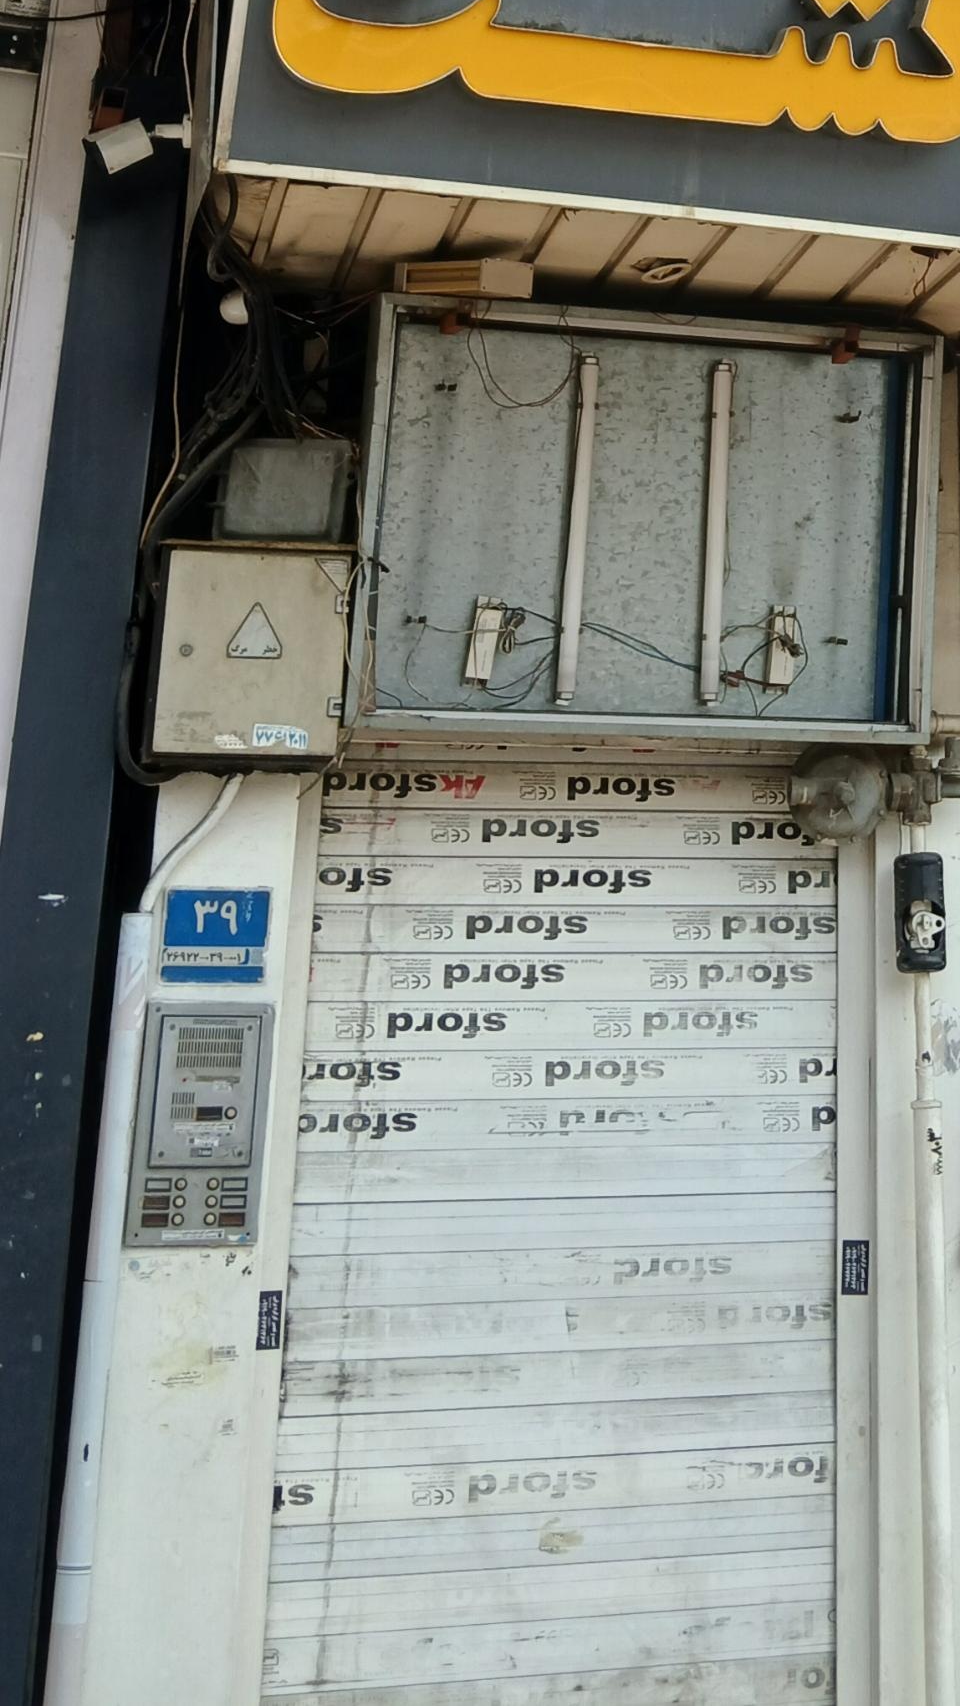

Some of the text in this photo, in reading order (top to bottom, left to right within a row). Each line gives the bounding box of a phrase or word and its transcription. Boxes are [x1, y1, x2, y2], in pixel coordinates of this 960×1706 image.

[482, 817, 599, 843] sford
[320, 866, 392, 891] sfo
[535, 869, 651, 893] sford
[193, 898, 239, 936] ۳۹
[466, 916, 587, 940] sford
[444, 964, 564, 989] sford
[387, 1013, 506, 1038] sford
[303, 1062, 401, 1088] sfor
